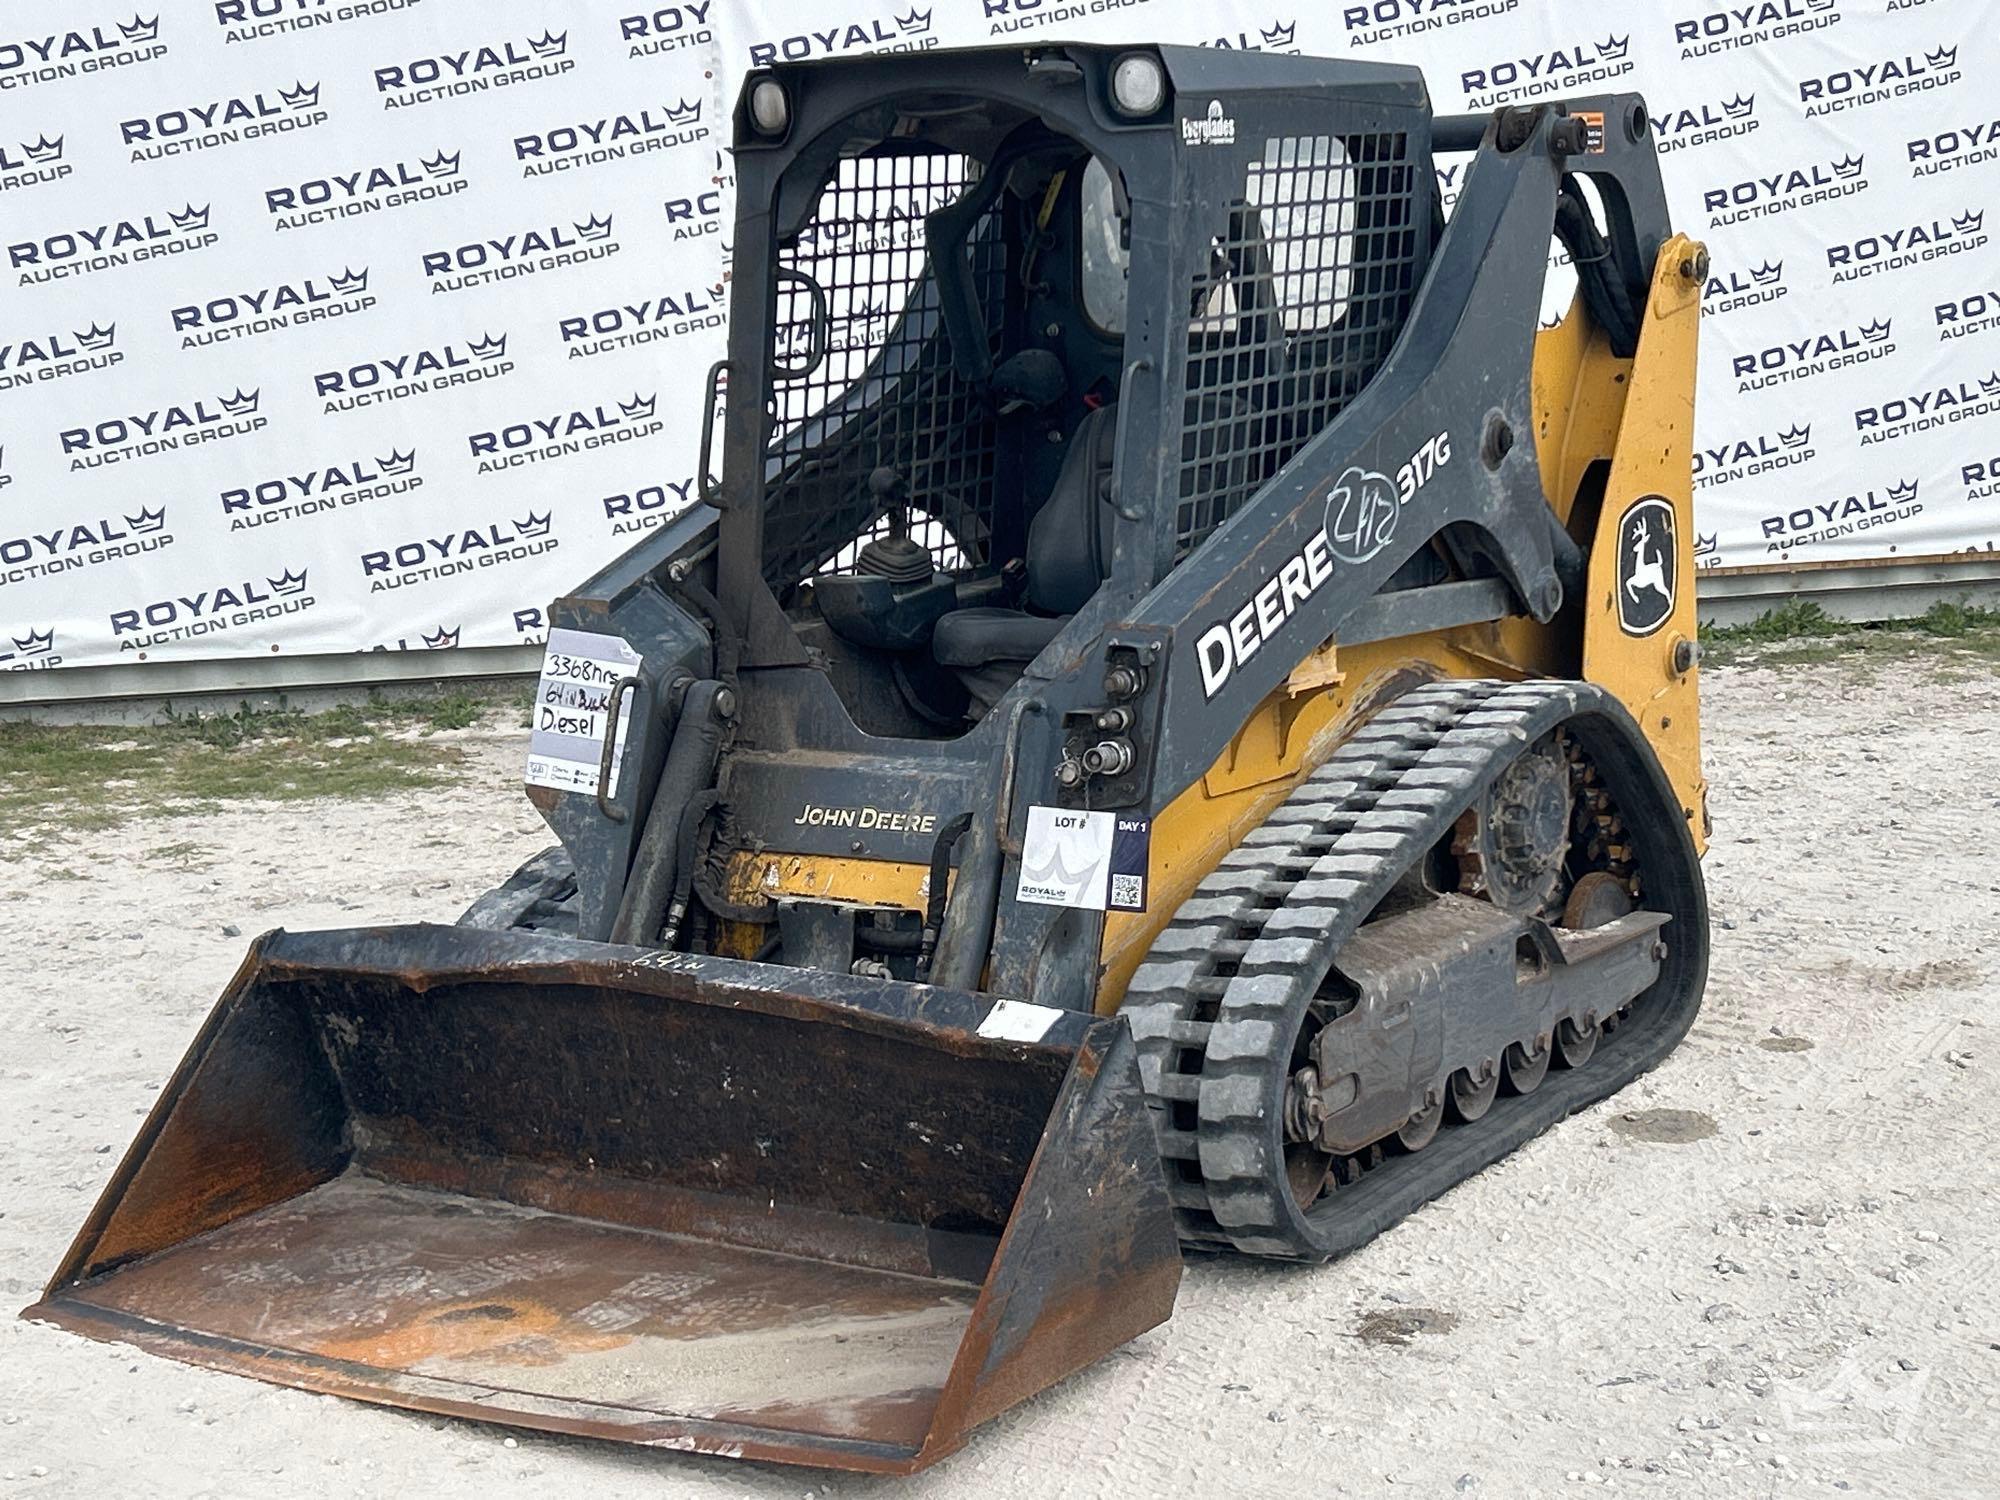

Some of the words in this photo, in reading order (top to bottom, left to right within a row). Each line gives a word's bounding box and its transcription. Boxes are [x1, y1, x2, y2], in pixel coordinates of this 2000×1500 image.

[226, 11, 332, 44] AUCTION
[620, 0, 710, 40] ROY
[750, 20, 896, 66] ROYAL
[990, 4, 1086, 36] AUCTION
[1351, 16, 1442, 47] AUCTION
[1447, 0, 1518, 24] GROUP
[1675, 0, 1804, 43] ROYAL
[1681, 30, 1768, 60] AUCTION
[1773, 13, 1840, 38] GROUP
[0, 27, 120, 70] OYAL
[0, 64, 76, 89] CTION
[81, 45, 167, 72] GROUP
[374, 43, 530, 92] ROYAL
[629, 30, 712, 59] AUCTIO
[385, 78, 488, 110] AUCTION
[493, 60, 574, 86] GROUP
[1461, 46, 1596, 93] ROYAL
[1468, 79, 1558, 111] AUCTION
[1563, 61, 1633, 88] GROUP
[1800, 57, 1925, 102] ROYAL
[1805, 88, 1890, 119] AUCTION
[1894, 71, 1961, 96] GROUP
[120, 94, 281, 145] ROYAL
[131, 130, 239, 163] AUCTION
[244, 112, 328, 138] GROUP
[514, 111, 665, 160] ROYAL
[1649, 105, 1722, 136] YAL
[1691, 120, 1759, 146] GROUP
[1907, 121, 2000, 162] ROYA
[524, 146, 625, 178] AUCTION
[630, 128, 709, 154] GROUP
[1913, 148, 1997, 178] AUCTION
[0, 165, 72, 190] ROUP
[265, 163, 423, 213] ROYAL
[1704, 166, 1832, 212] ROYAL
[276, 198, 381, 231] AUCTION
[386, 180, 468, 207] GROUP
[1710, 198, 1796, 229] AUCTION
[1801, 180, 1868, 206] GROUP
[8, 217, 171, 268] ROYAL
[19, 253, 128, 286] AUCTION
[133, 234, 218, 261] GROUP
[423, 227, 576, 276] ROYAL
[1827, 221, 1952, 267] ROYAL
[1833, 253, 1917, 284] AUCTION
[1922, 236, 1988, 261] GROUP
[432, 261, 535, 294] AUCTION
[540, 243, 620, 270] GROUP
[171, 281, 331, 332] ROYAL
[559, 292, 709, 342] ROYAL
[1719, 287, 1787, 312] GROUP
[182, 316, 288, 350] AUCTION
[293, 297, 376, 324] GROUP
[569, 326, 669, 359] AUCTION
[674, 313, 726, 335] GRO
[1940, 316, 2000, 341] AUCTI
[38, 352, 124, 380] GROUP
[314, 346, 470, 397] ROYAL
[1733, 330, 1860, 377] ROYAL
[1738, 362, 1824, 393] AUCTION
[1829, 344, 1896, 369] GROUP
[324, 381, 428, 414] AUCTION
[433, 362, 514, 389] GROUP
[1855, 384, 1979, 431] ROYAL
[60, 402, 221, 454] ROYAL
[71, 437, 178, 472] AUCTION
[183, 417, 267, 446] GROUP
[469, 406, 620, 457] ROYAL
[1861, 415, 1944, 446] AUCTION
[1949, 399, 2000, 422] GROU
[478, 441, 579, 474] AUCTION
[584, 421, 663, 449] GROUP
[1396, 431, 1451, 505] 317G
[1692, 468, 1743, 491] TION
[1748, 450, 1815, 475] GROUP
[220, 462, 378, 514] ROYAL
[231, 497, 336, 531] AUCTION
[341, 477, 423, 505] GROUP
[603, 478, 693, 519] ROY
[1761, 492, 1887, 538] ROYAL
[1767, 523, 1853, 553] AUCTION
[1857, 504, 1923, 530] GROUP
[0, 520, 127, 564] OYAL
[0, 555, 83, 585] CTION
[89, 535, 173, 564] GROUP
[361, 525, 515, 576] ROYAL
[371, 559, 473, 593] AUCTION
[479, 539, 558, 567] GROUP
[110, 583, 269, 635] ROYAL
[120, 618, 227, 652] AUCTION
[232, 597, 315, 625] GROUP
[1196, 528, 1333, 698] DEERE
[546, 655, 618, 684] 3368hrs
[541, 707, 595, 737] Diesel
[795, 804, 855, 827] JOHN
[858, 807, 936, 833] DEERE
[1055, 817, 1077, 828] LOT
[1079, 819, 1087, 830] #
[1118, 821, 1139, 832] DAY
[1140, 822, 1146, 833] 1
[1022, 886, 1057, 896] ROYAL
